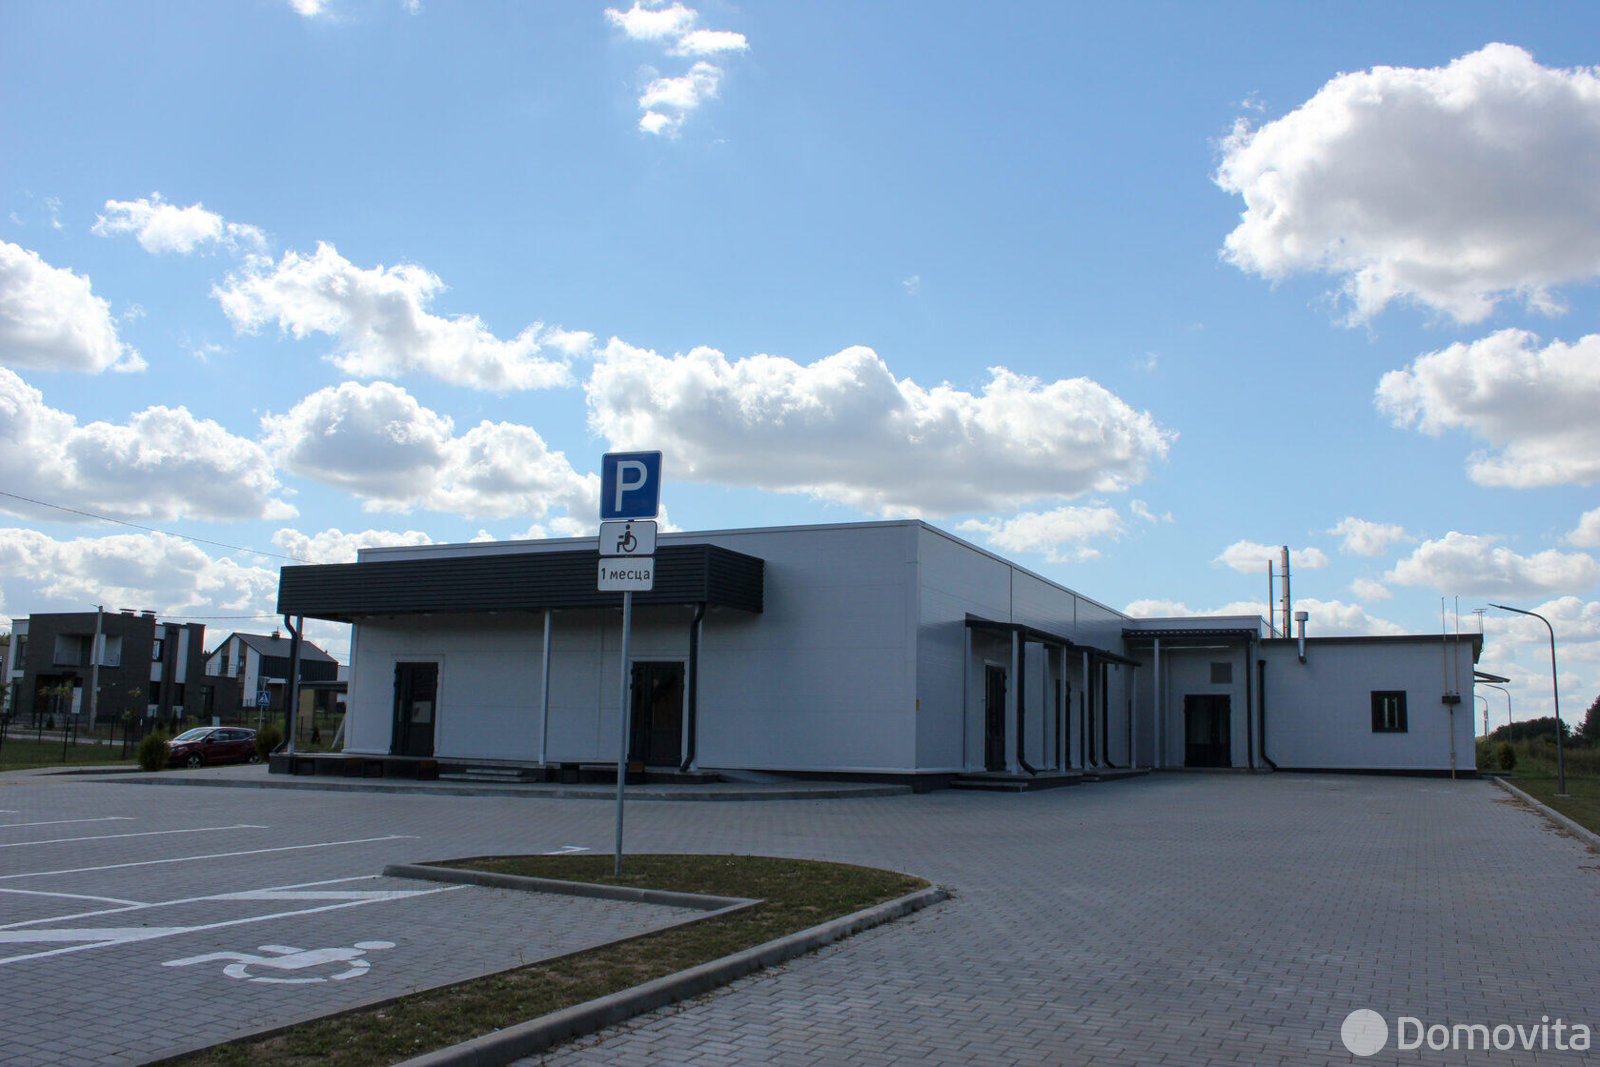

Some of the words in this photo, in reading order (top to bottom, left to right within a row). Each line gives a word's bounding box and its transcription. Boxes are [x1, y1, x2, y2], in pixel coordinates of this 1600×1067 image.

[615, 460, 648, 512] P
[601, 567, 606, 580] 1
[610, 569, 650, 581] месца
